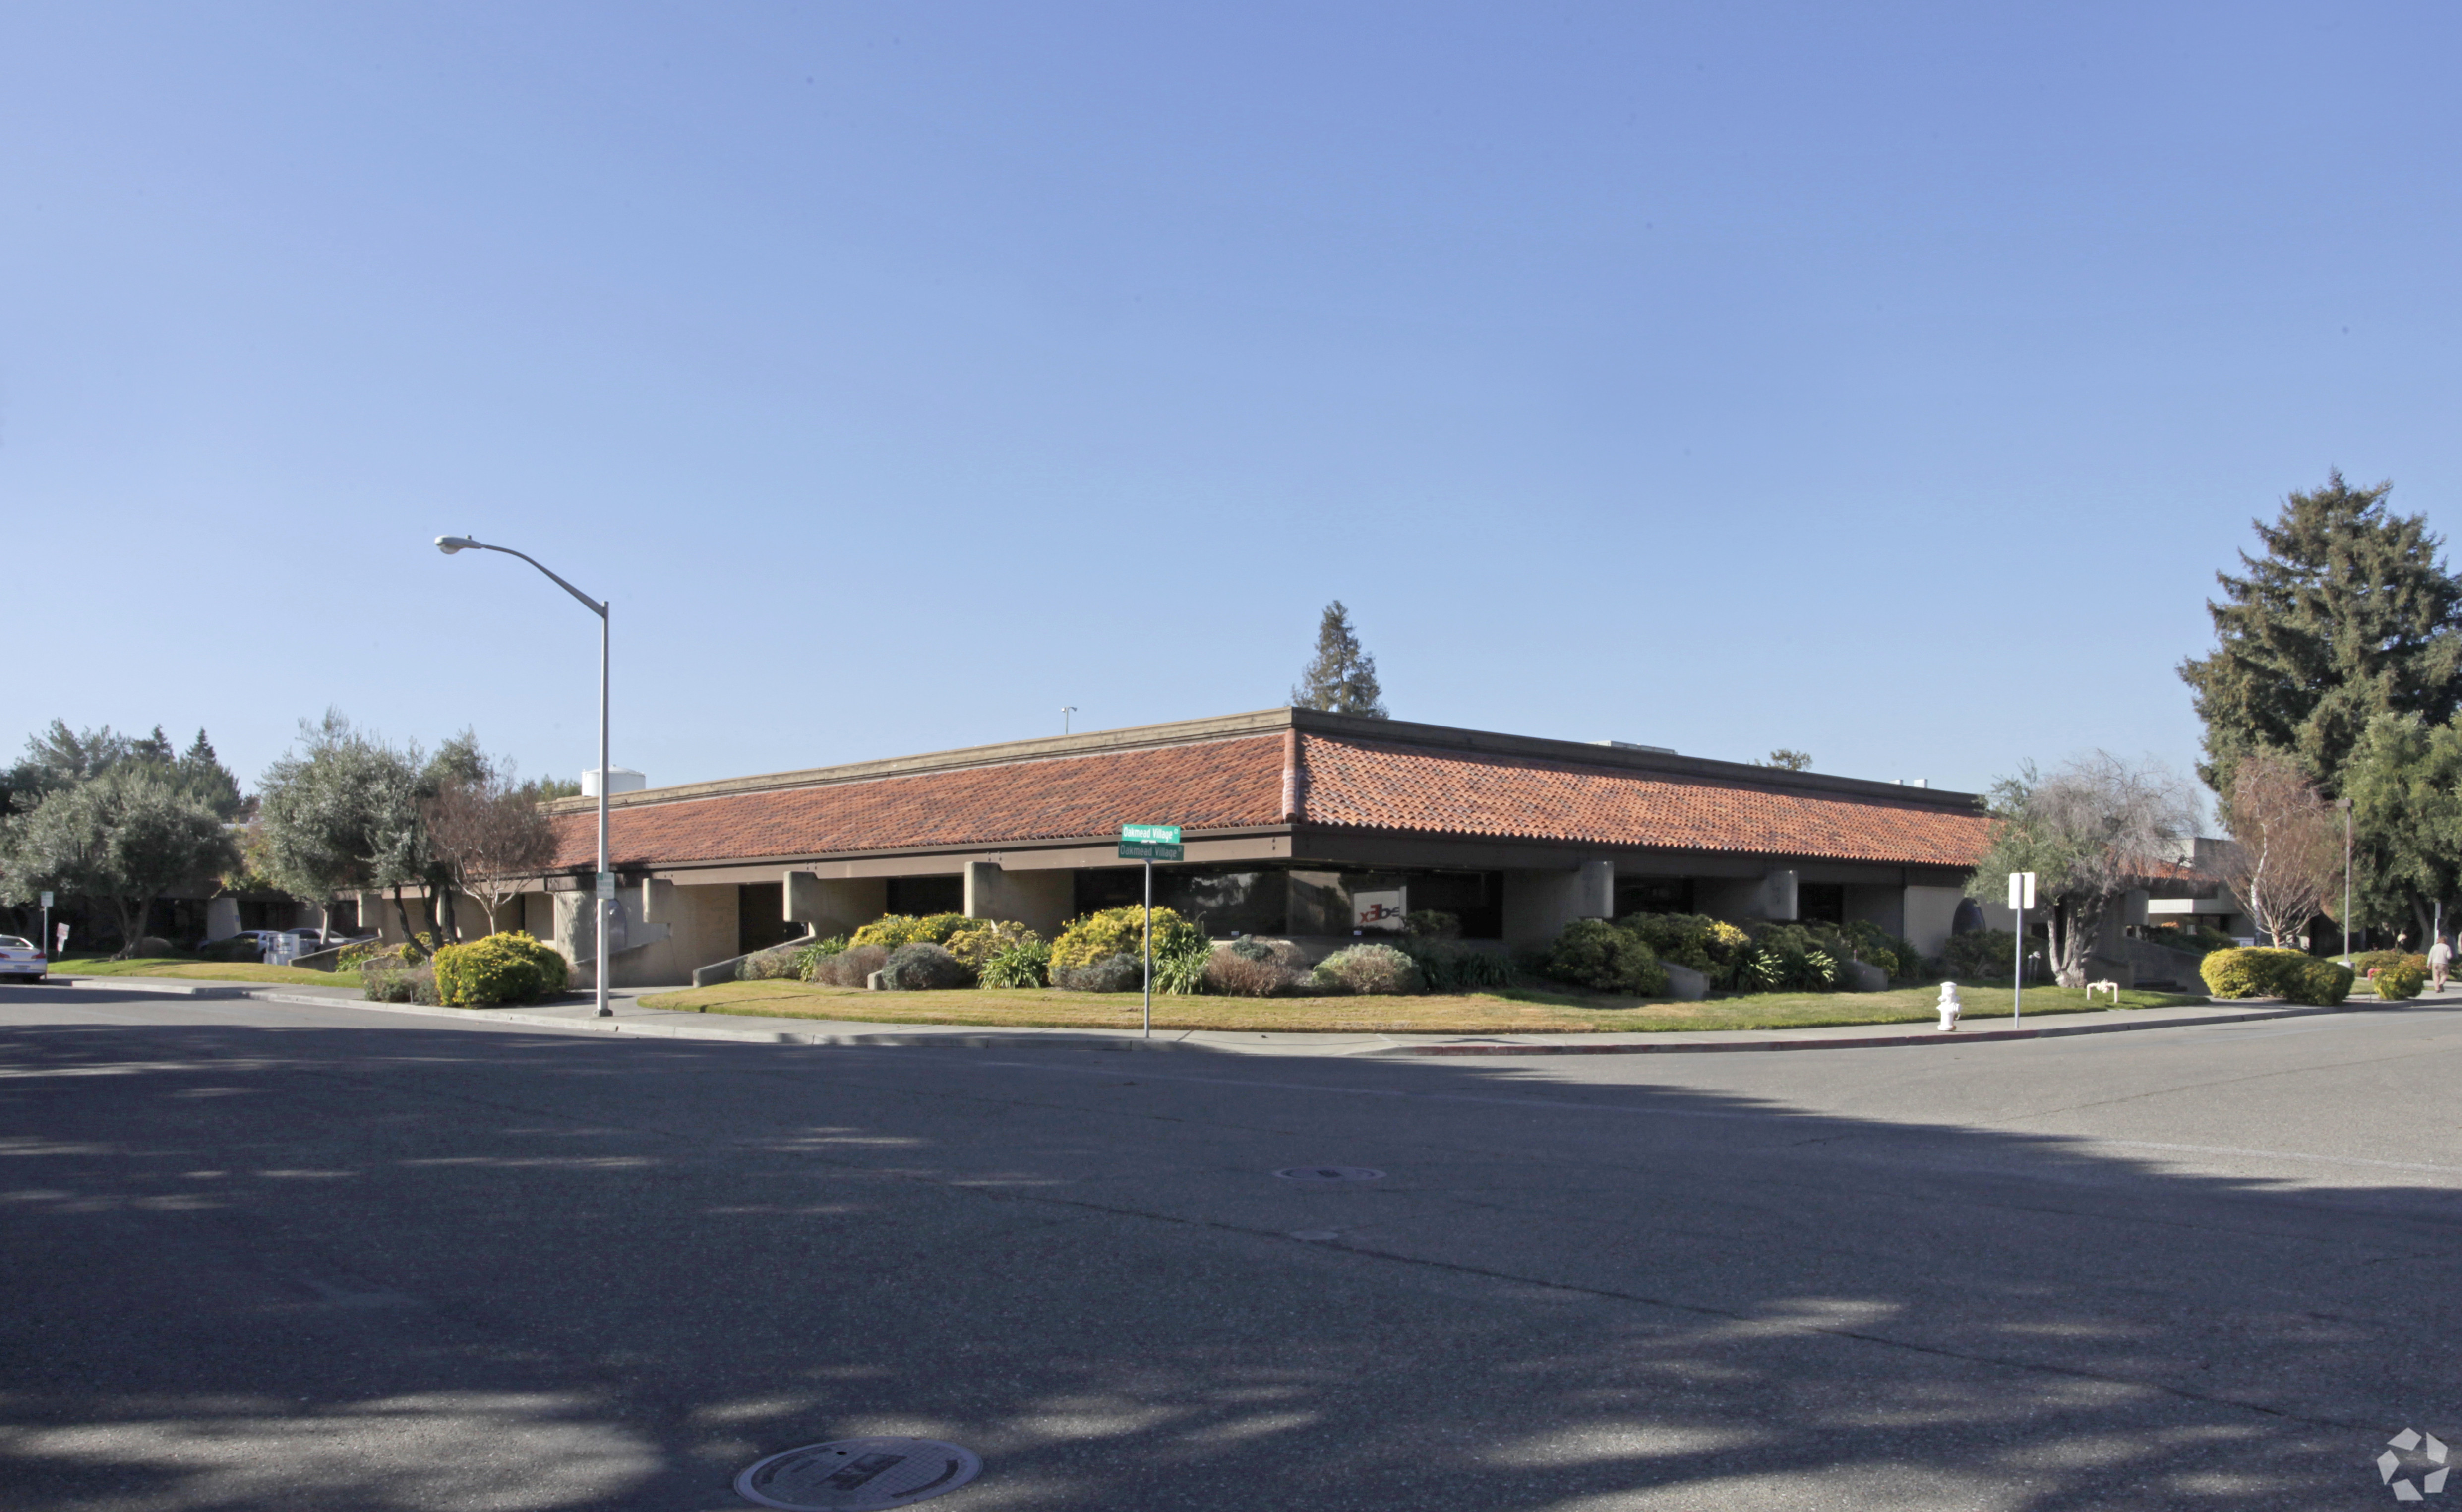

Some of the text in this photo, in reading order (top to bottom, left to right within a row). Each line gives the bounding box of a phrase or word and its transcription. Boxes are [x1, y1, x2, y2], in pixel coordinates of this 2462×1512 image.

[1124, 827, 1150, 838] Oakmead
[1152, 828, 1173, 842] Village
[1120, 845, 1152, 856] Oakmead
[1155, 847, 1177, 860] Village
